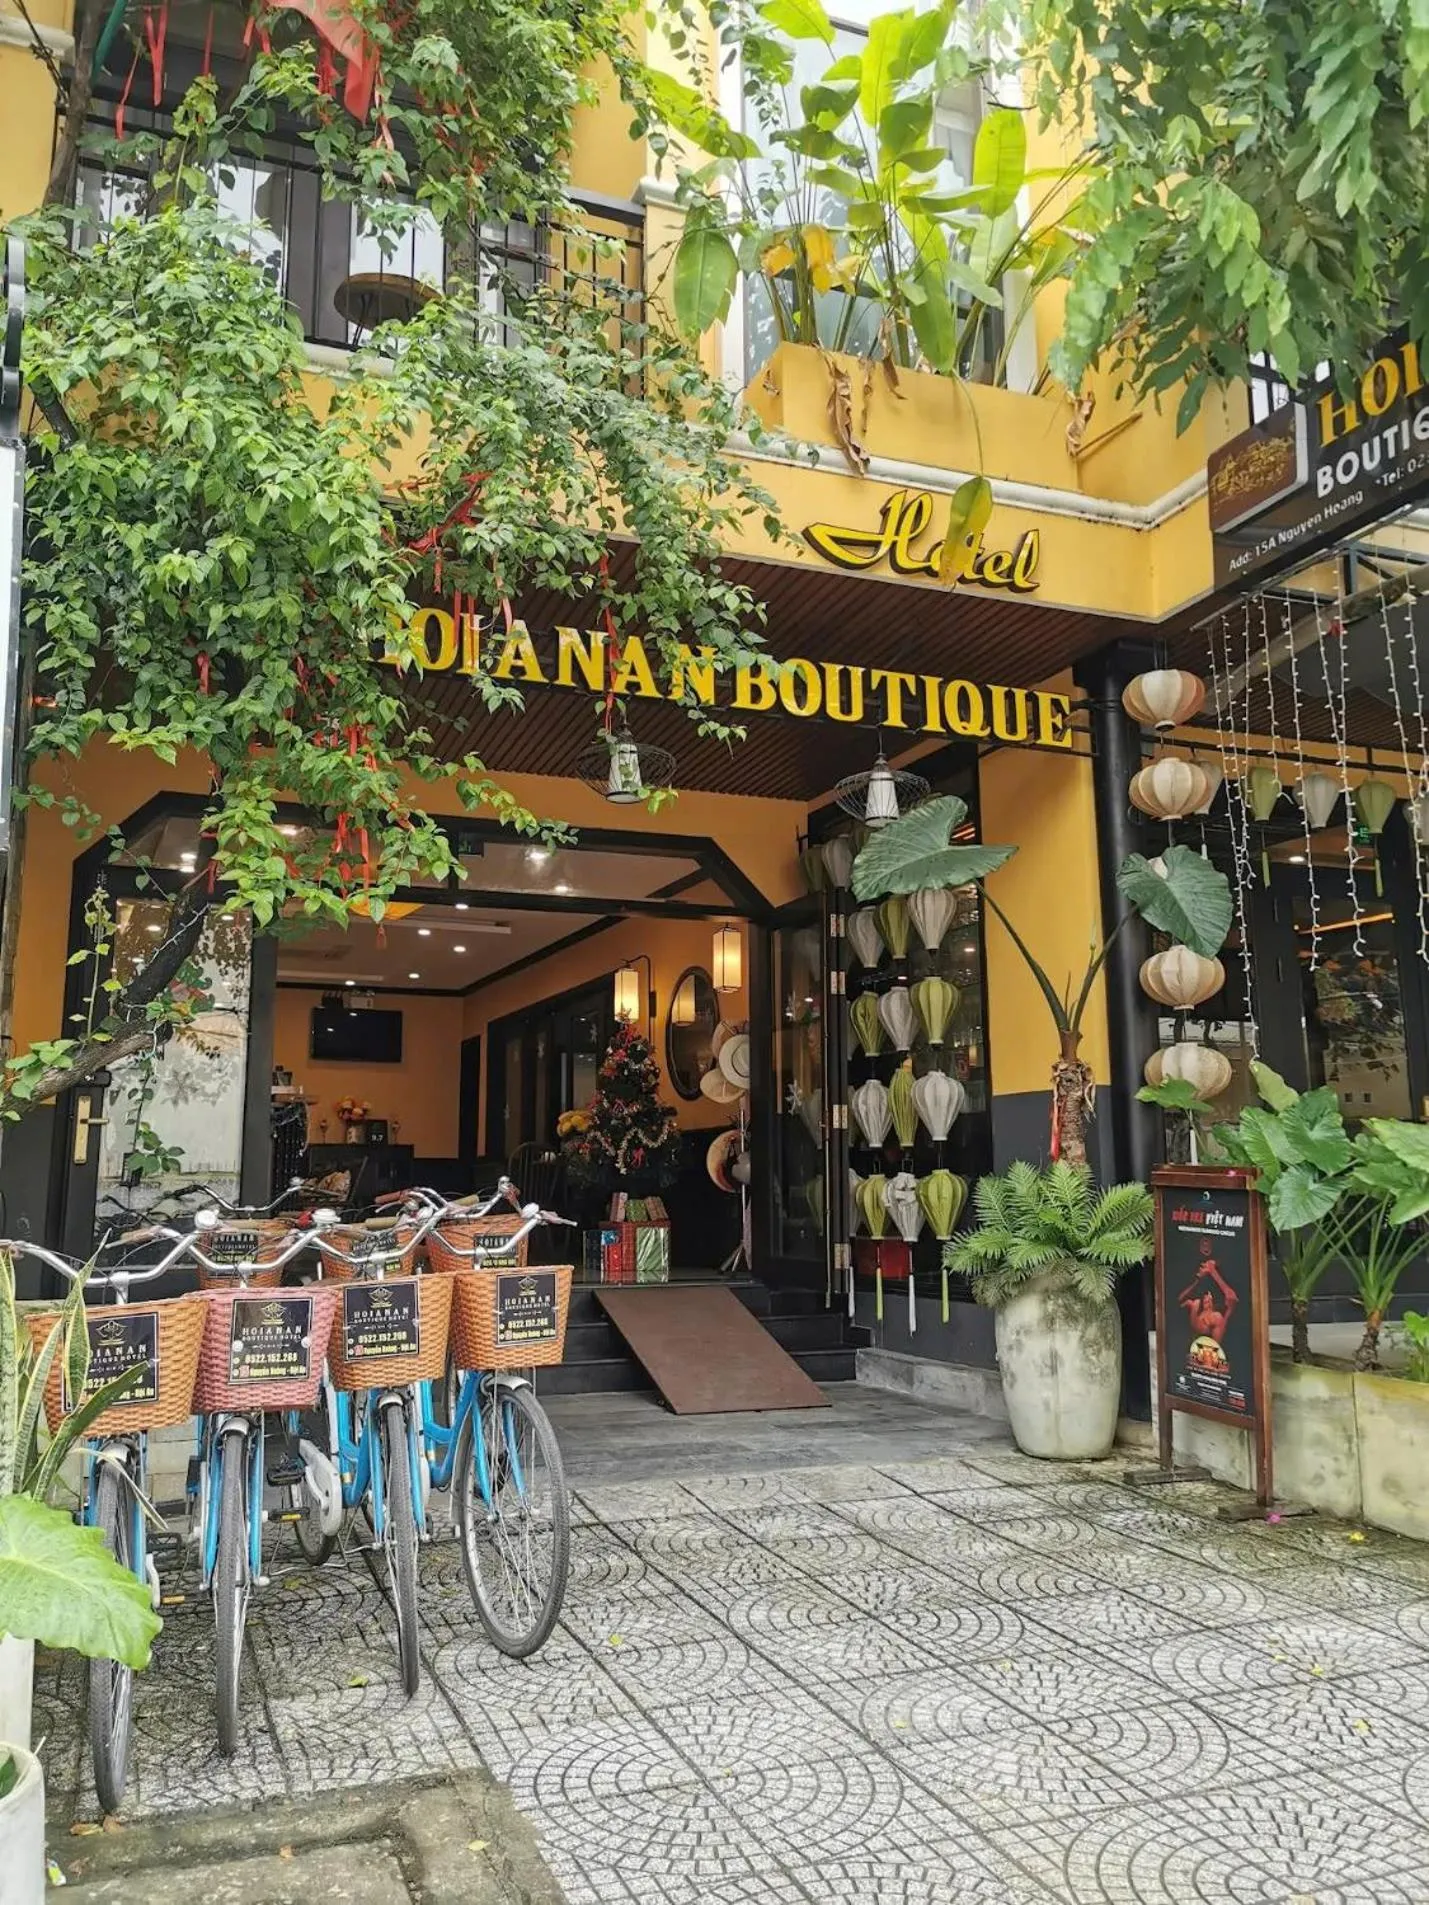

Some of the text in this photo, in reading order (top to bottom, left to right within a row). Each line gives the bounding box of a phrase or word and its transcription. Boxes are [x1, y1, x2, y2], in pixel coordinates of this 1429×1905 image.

[1229, 490, 1364, 572] Add: 15A Nguyen Hoang
[731, 657, 1073, 748] BOUTIQUE
[241, 1325, 303, 1336] HOIANAN
[353, 1306, 409, 1319] HOIANAN
